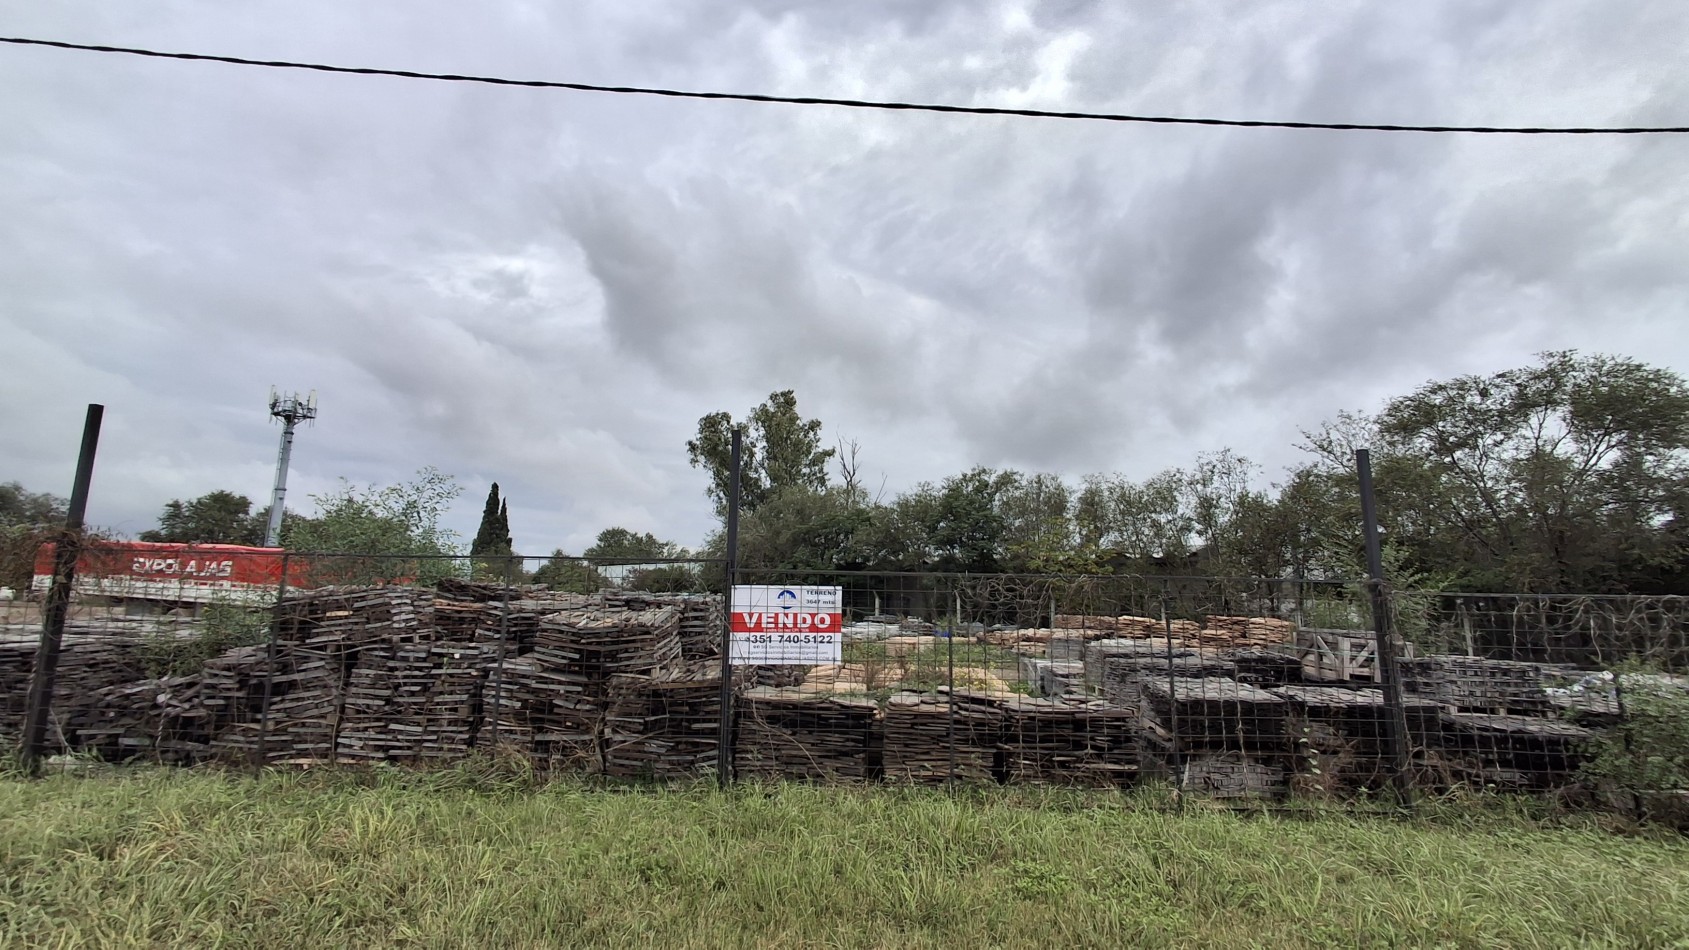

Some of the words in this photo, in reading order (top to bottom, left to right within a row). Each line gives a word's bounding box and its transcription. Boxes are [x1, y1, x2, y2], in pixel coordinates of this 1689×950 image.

[742, 612, 831, 628] VENDO
[751, 634, 773, 644] 351
[778, 634, 833, 644] 740-5122
